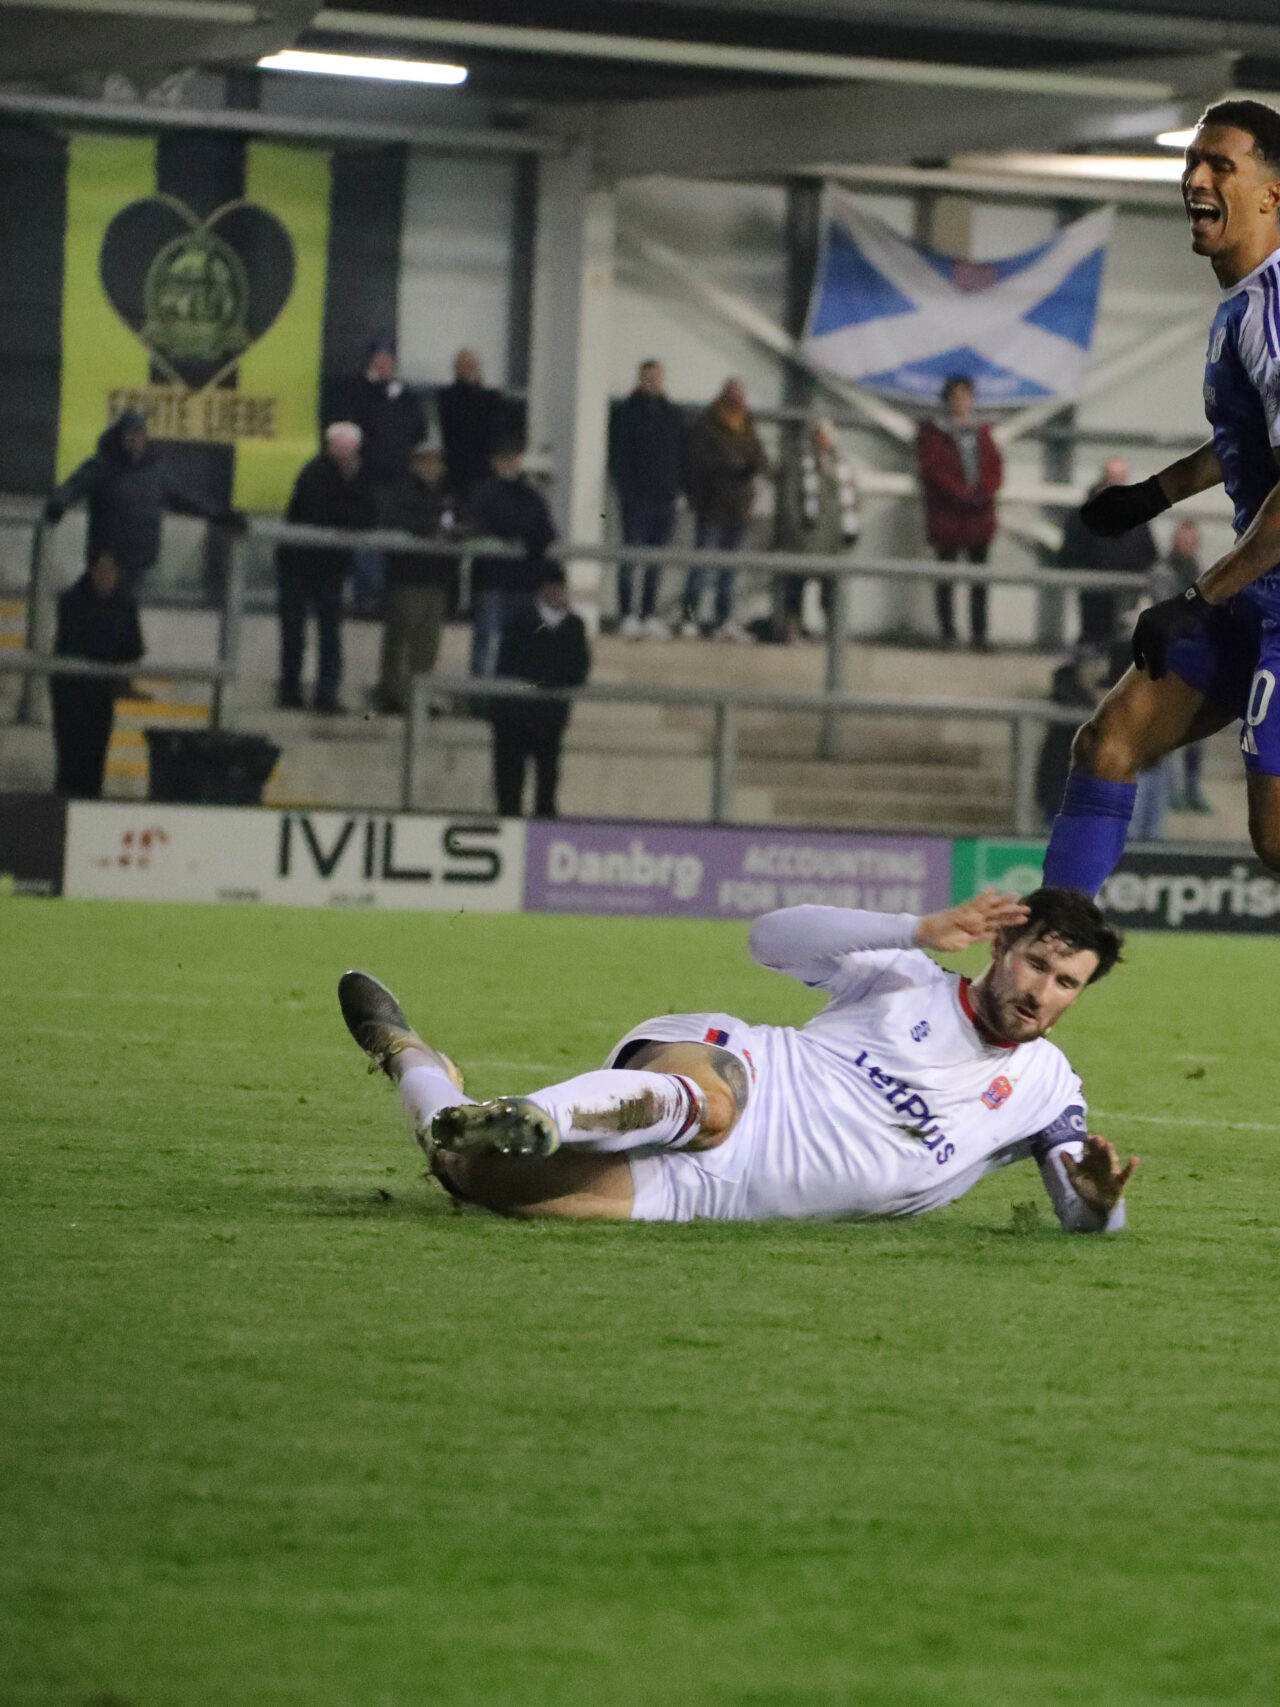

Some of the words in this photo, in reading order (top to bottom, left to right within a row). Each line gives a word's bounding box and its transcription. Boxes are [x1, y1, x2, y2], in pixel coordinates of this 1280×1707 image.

[547, 840, 704, 900] Danbrg
[743, 843, 927, 880] ACCOUNTING
[716, 879, 779, 912] FOR
